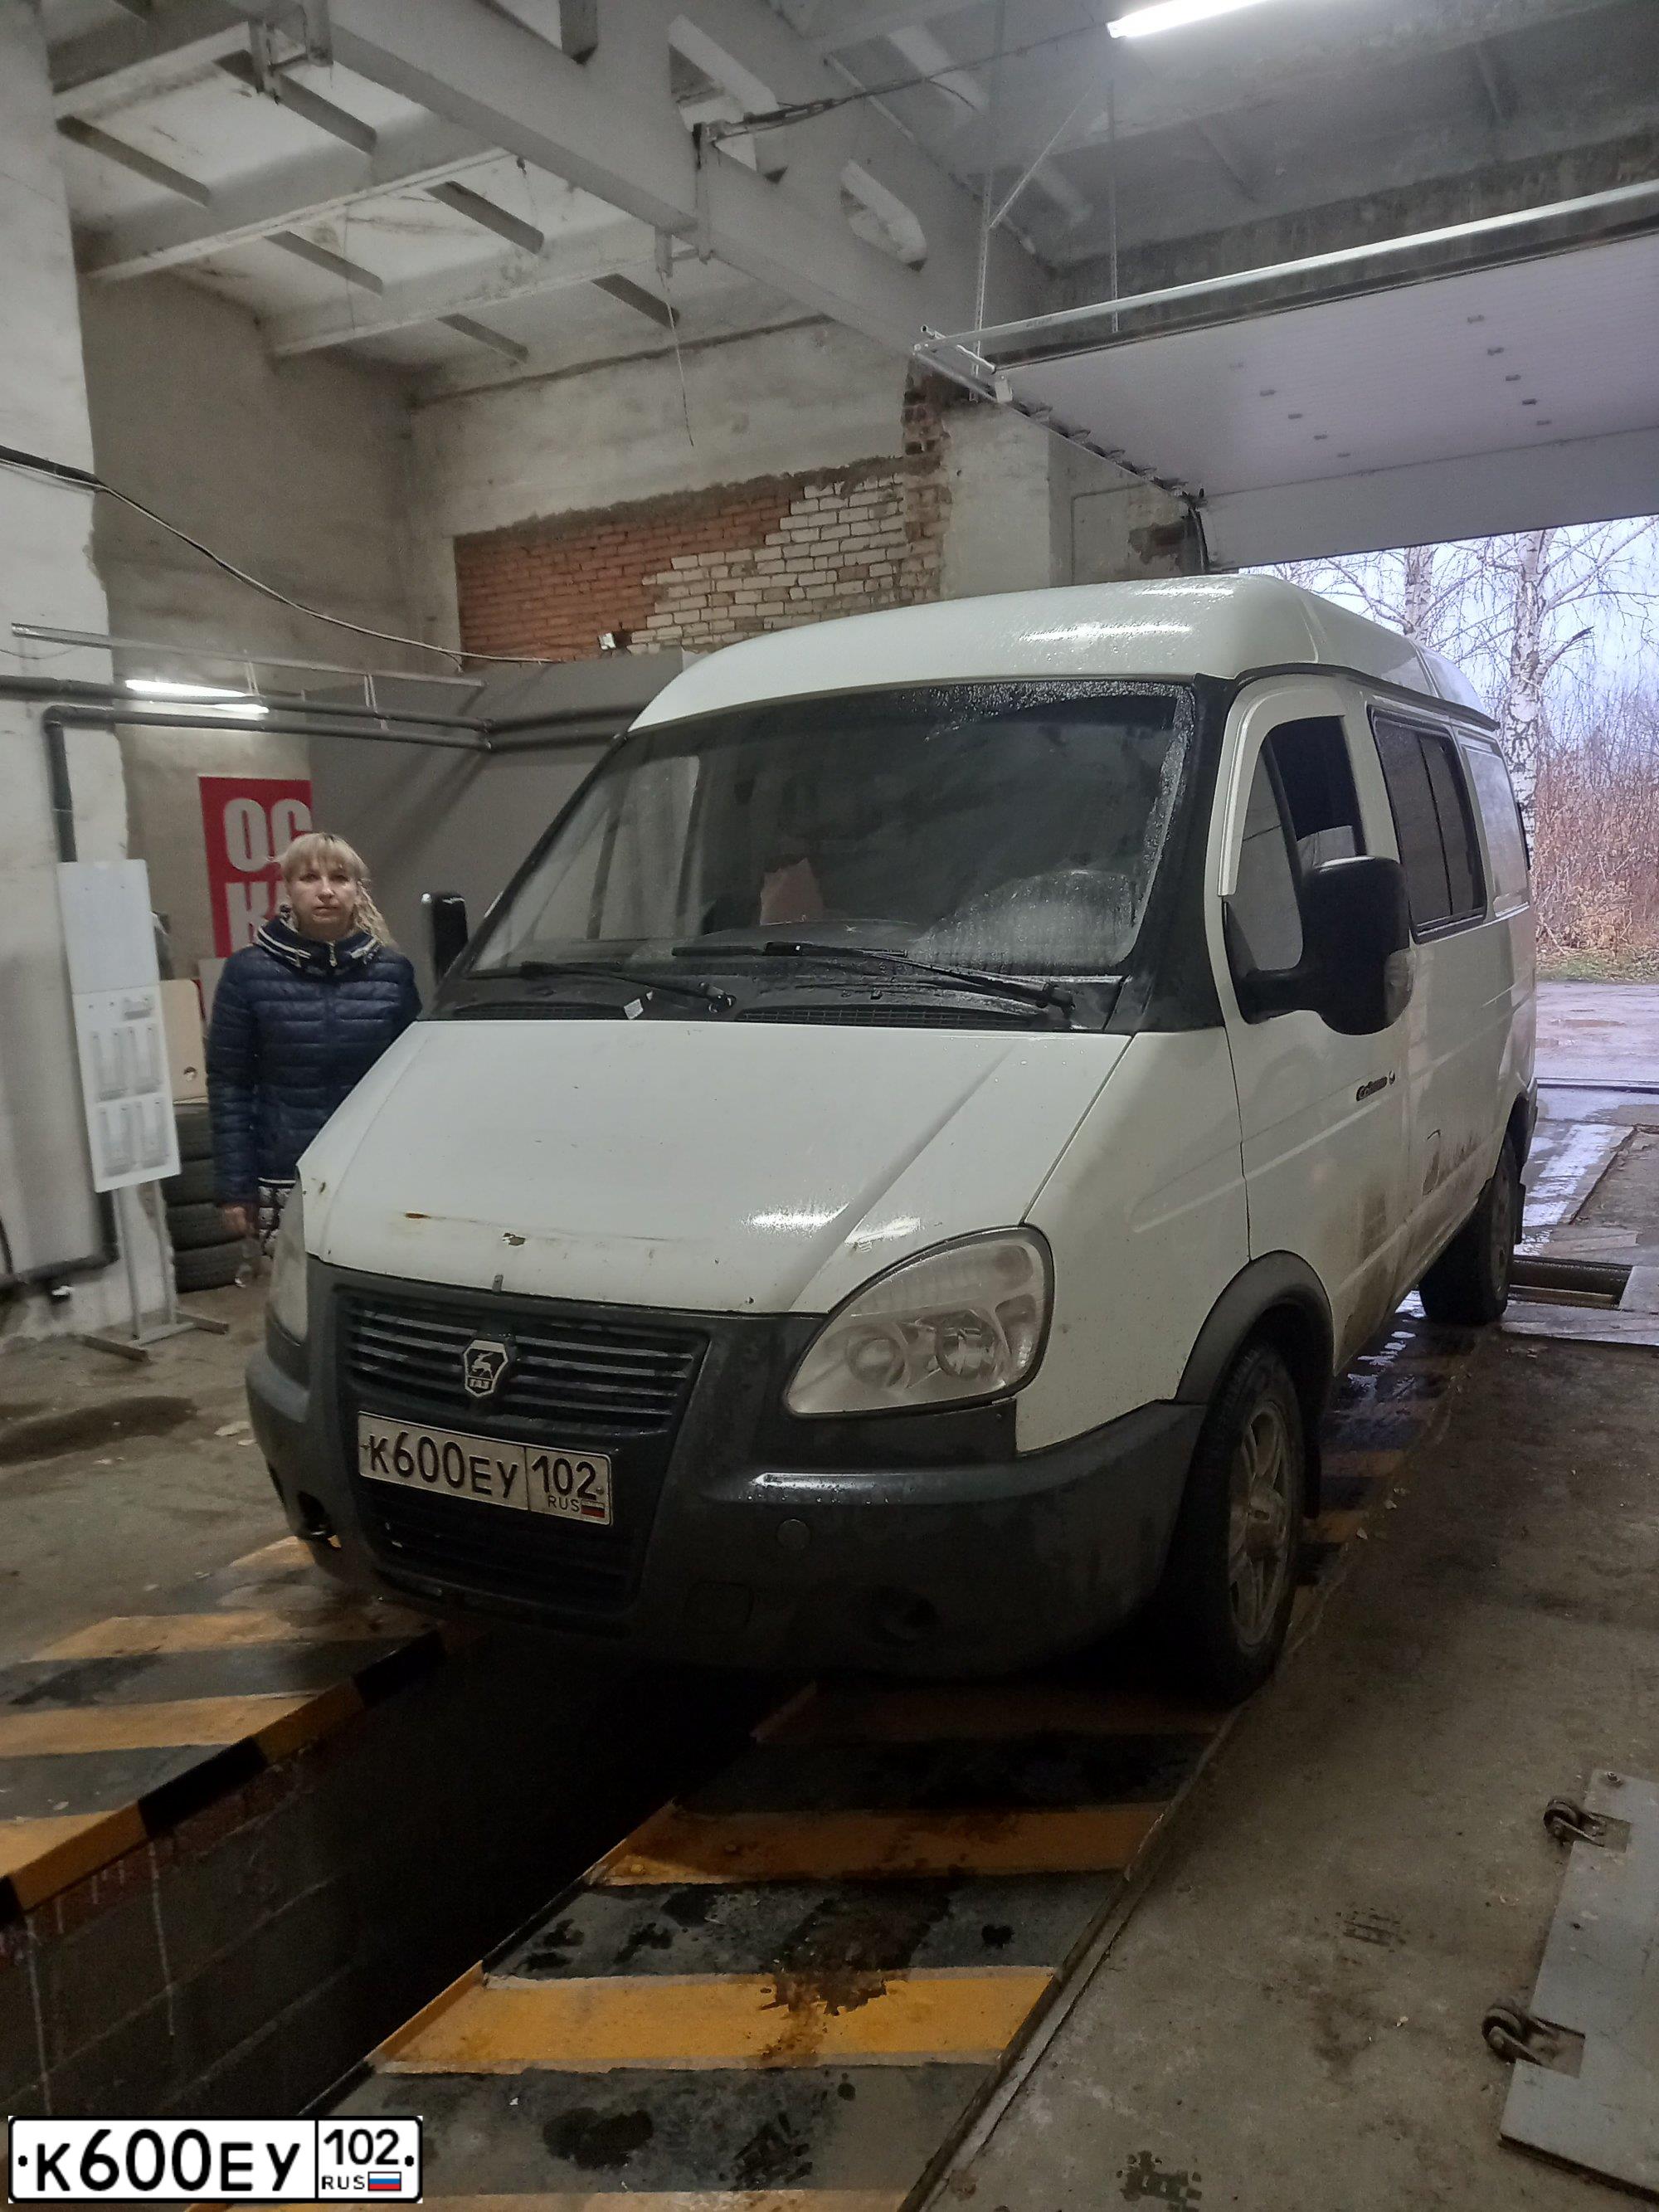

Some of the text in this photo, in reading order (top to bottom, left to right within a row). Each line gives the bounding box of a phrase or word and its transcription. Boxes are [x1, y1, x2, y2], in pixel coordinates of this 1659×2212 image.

[368, 1431, 598, 1499] К600ЕУ 102
[547, 1494, 581, 1513] RUS
